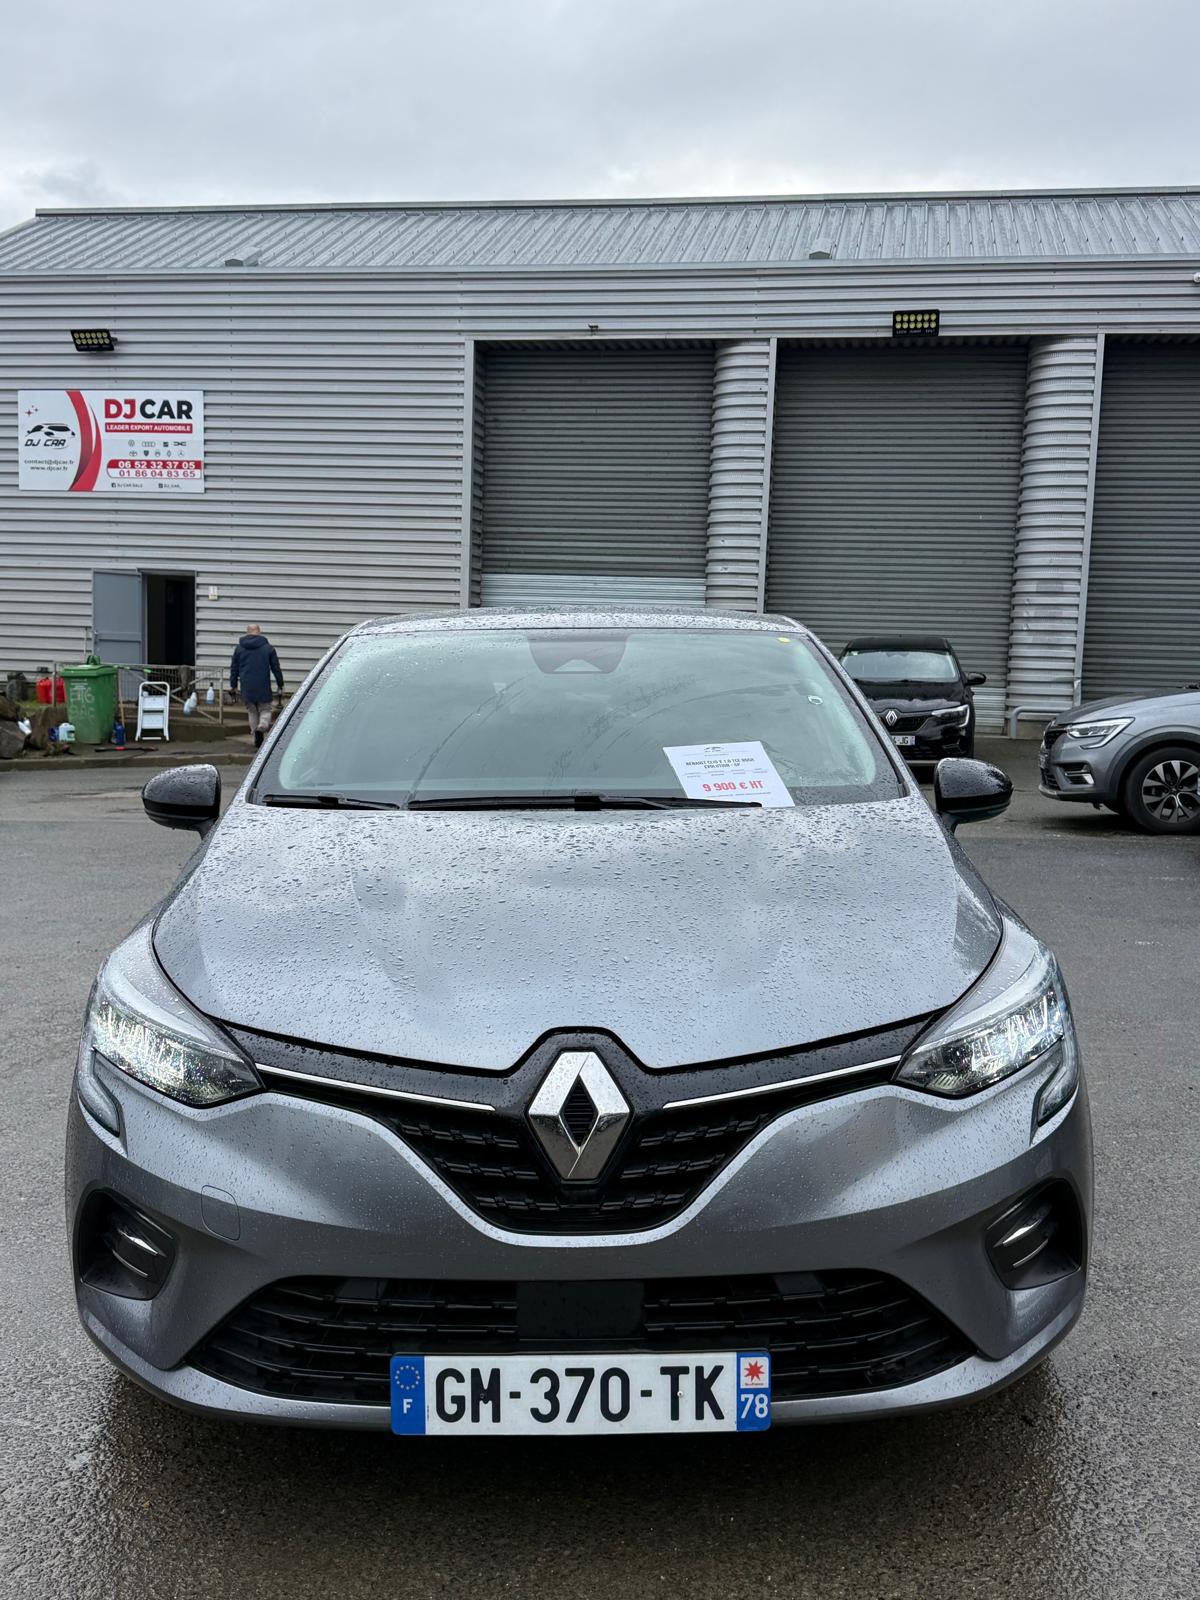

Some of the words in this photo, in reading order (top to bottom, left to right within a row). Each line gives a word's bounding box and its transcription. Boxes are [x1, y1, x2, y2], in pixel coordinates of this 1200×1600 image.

[104, 399, 136, 419] DJ
[139, 399, 193, 419] CAR
[24, 438, 41, 447] DJ
[43, 438, 66, 447] CAR
[150, 461, 163, 469] 32
[166, 461, 179, 469] 37
[119, 469, 130, 477] 01
[135, 469, 147, 477] 86
[167, 470, 179, 478] 83
[183, 470, 196, 478] 65
[702, 783, 712, 792] 9
[713, 782, 737, 791] 900
[739, 782, 748, 790] €
[749, 780, 764, 789] HT
[402, 1398, 413, 1414] F
[435, 1365, 725, 1424] GM-370-TK
[740, 1393, 768, 1418] 78
